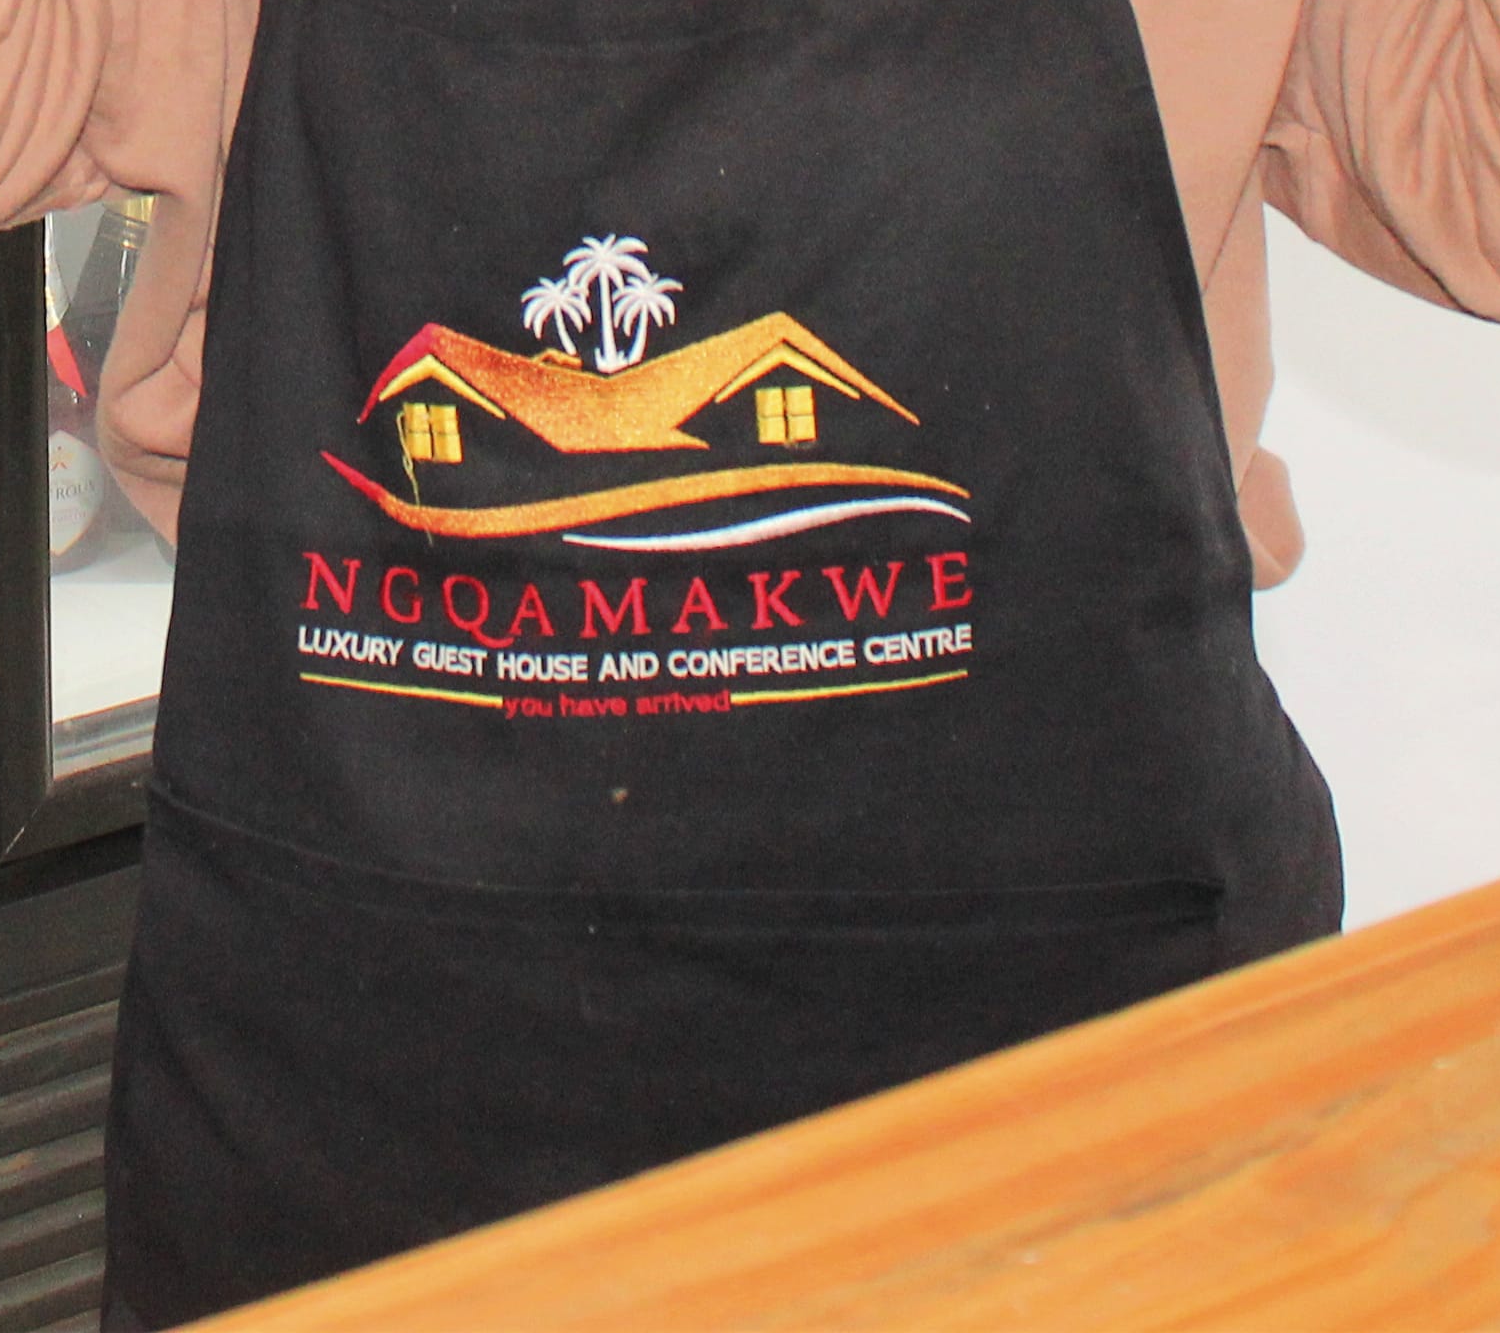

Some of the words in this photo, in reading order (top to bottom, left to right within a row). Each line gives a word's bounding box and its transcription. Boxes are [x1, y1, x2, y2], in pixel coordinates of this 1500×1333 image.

[300, 551, 974, 649] NGQAMAKWE
[298, 626, 404, 666] LUXURY
[413, 641, 488, 676] GUEST
[497, 651, 589, 682] HOUSE
[598, 650, 660, 682] AND
[667, 639, 857, 679] CONFERENCE
[863, 623, 973, 665] CENTRE
[504, 695, 553, 720] you
[559, 692, 627, 718] have
[635, 689, 731, 717] arrived
